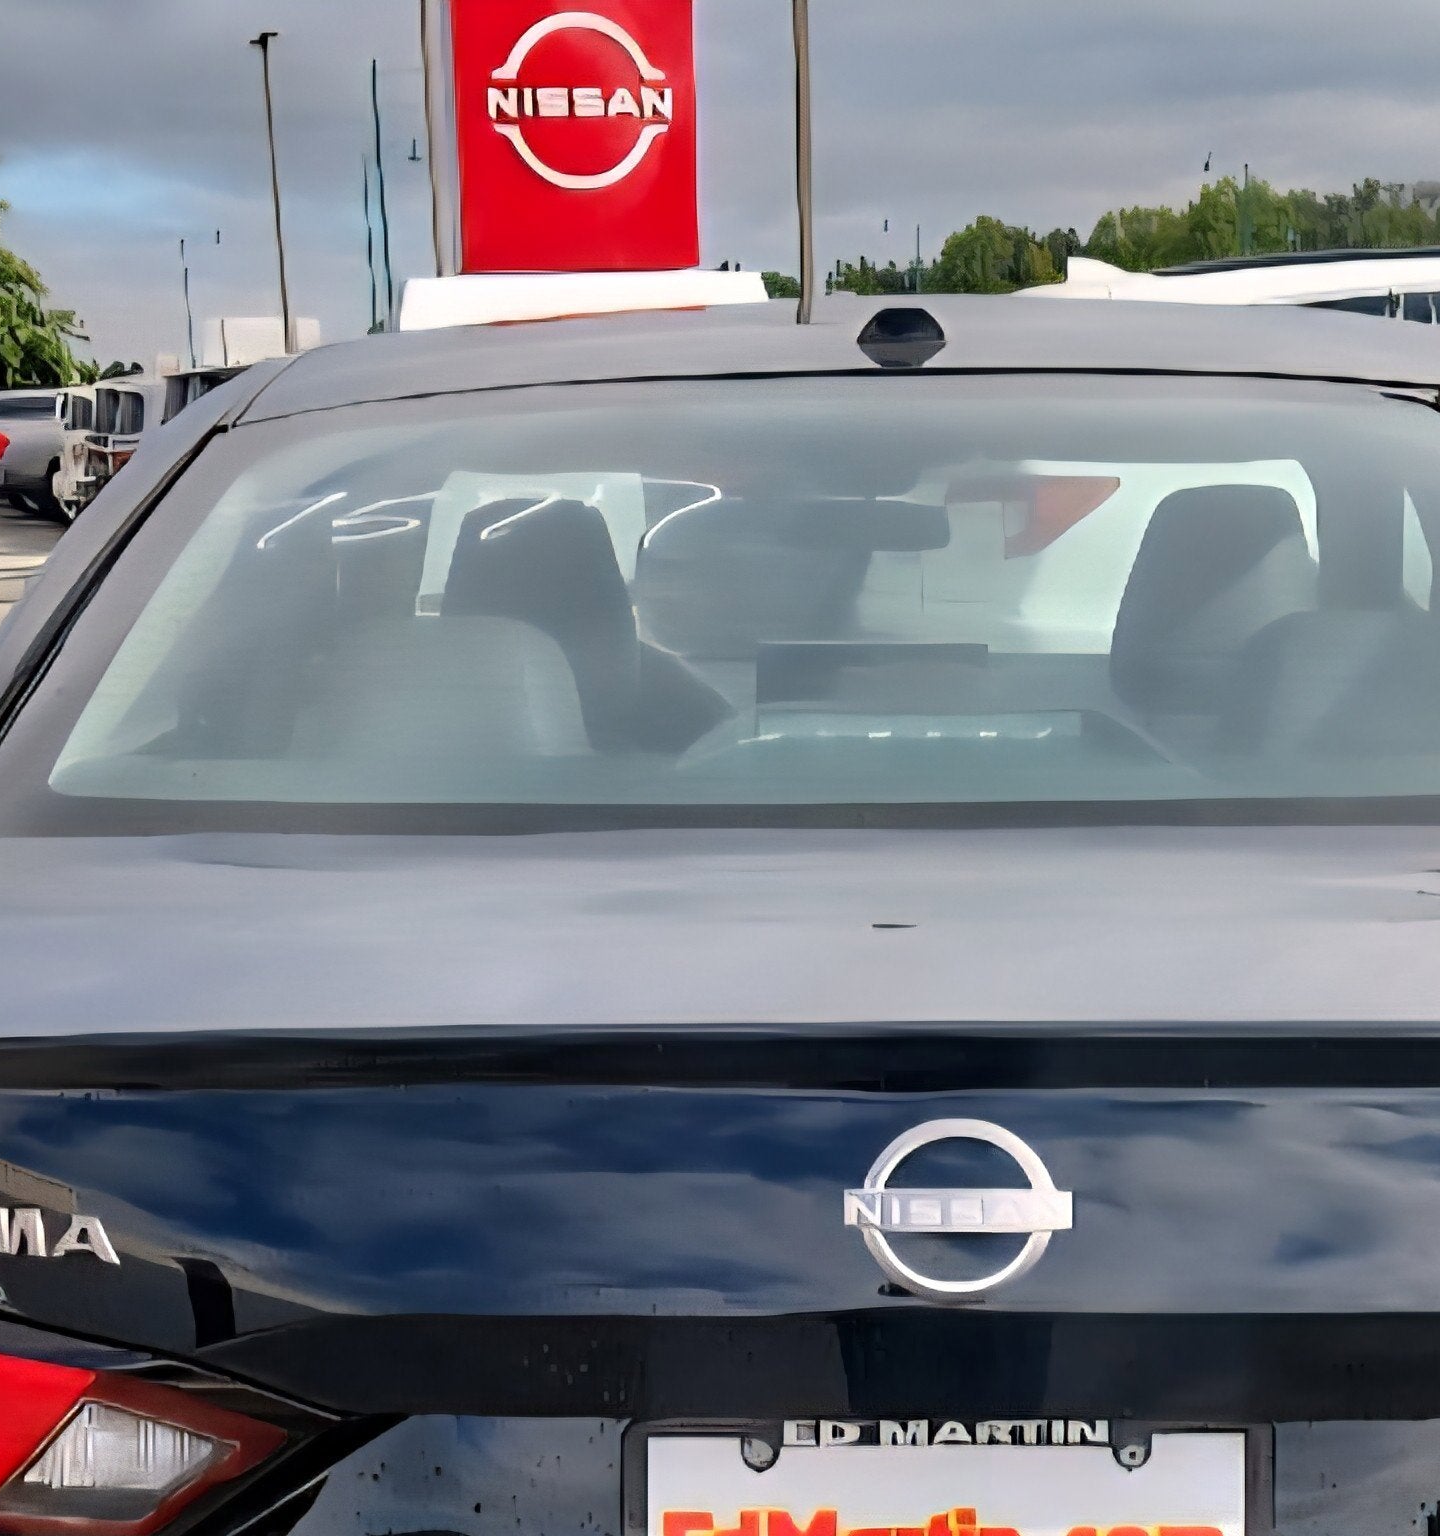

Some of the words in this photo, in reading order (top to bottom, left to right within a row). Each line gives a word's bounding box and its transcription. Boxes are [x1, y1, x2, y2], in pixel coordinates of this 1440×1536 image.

[487, 86, 673, 119] NISSAN
[783, 1419, 860, 1448] ED
[879, 1419, 1110, 1446] MARTIN
